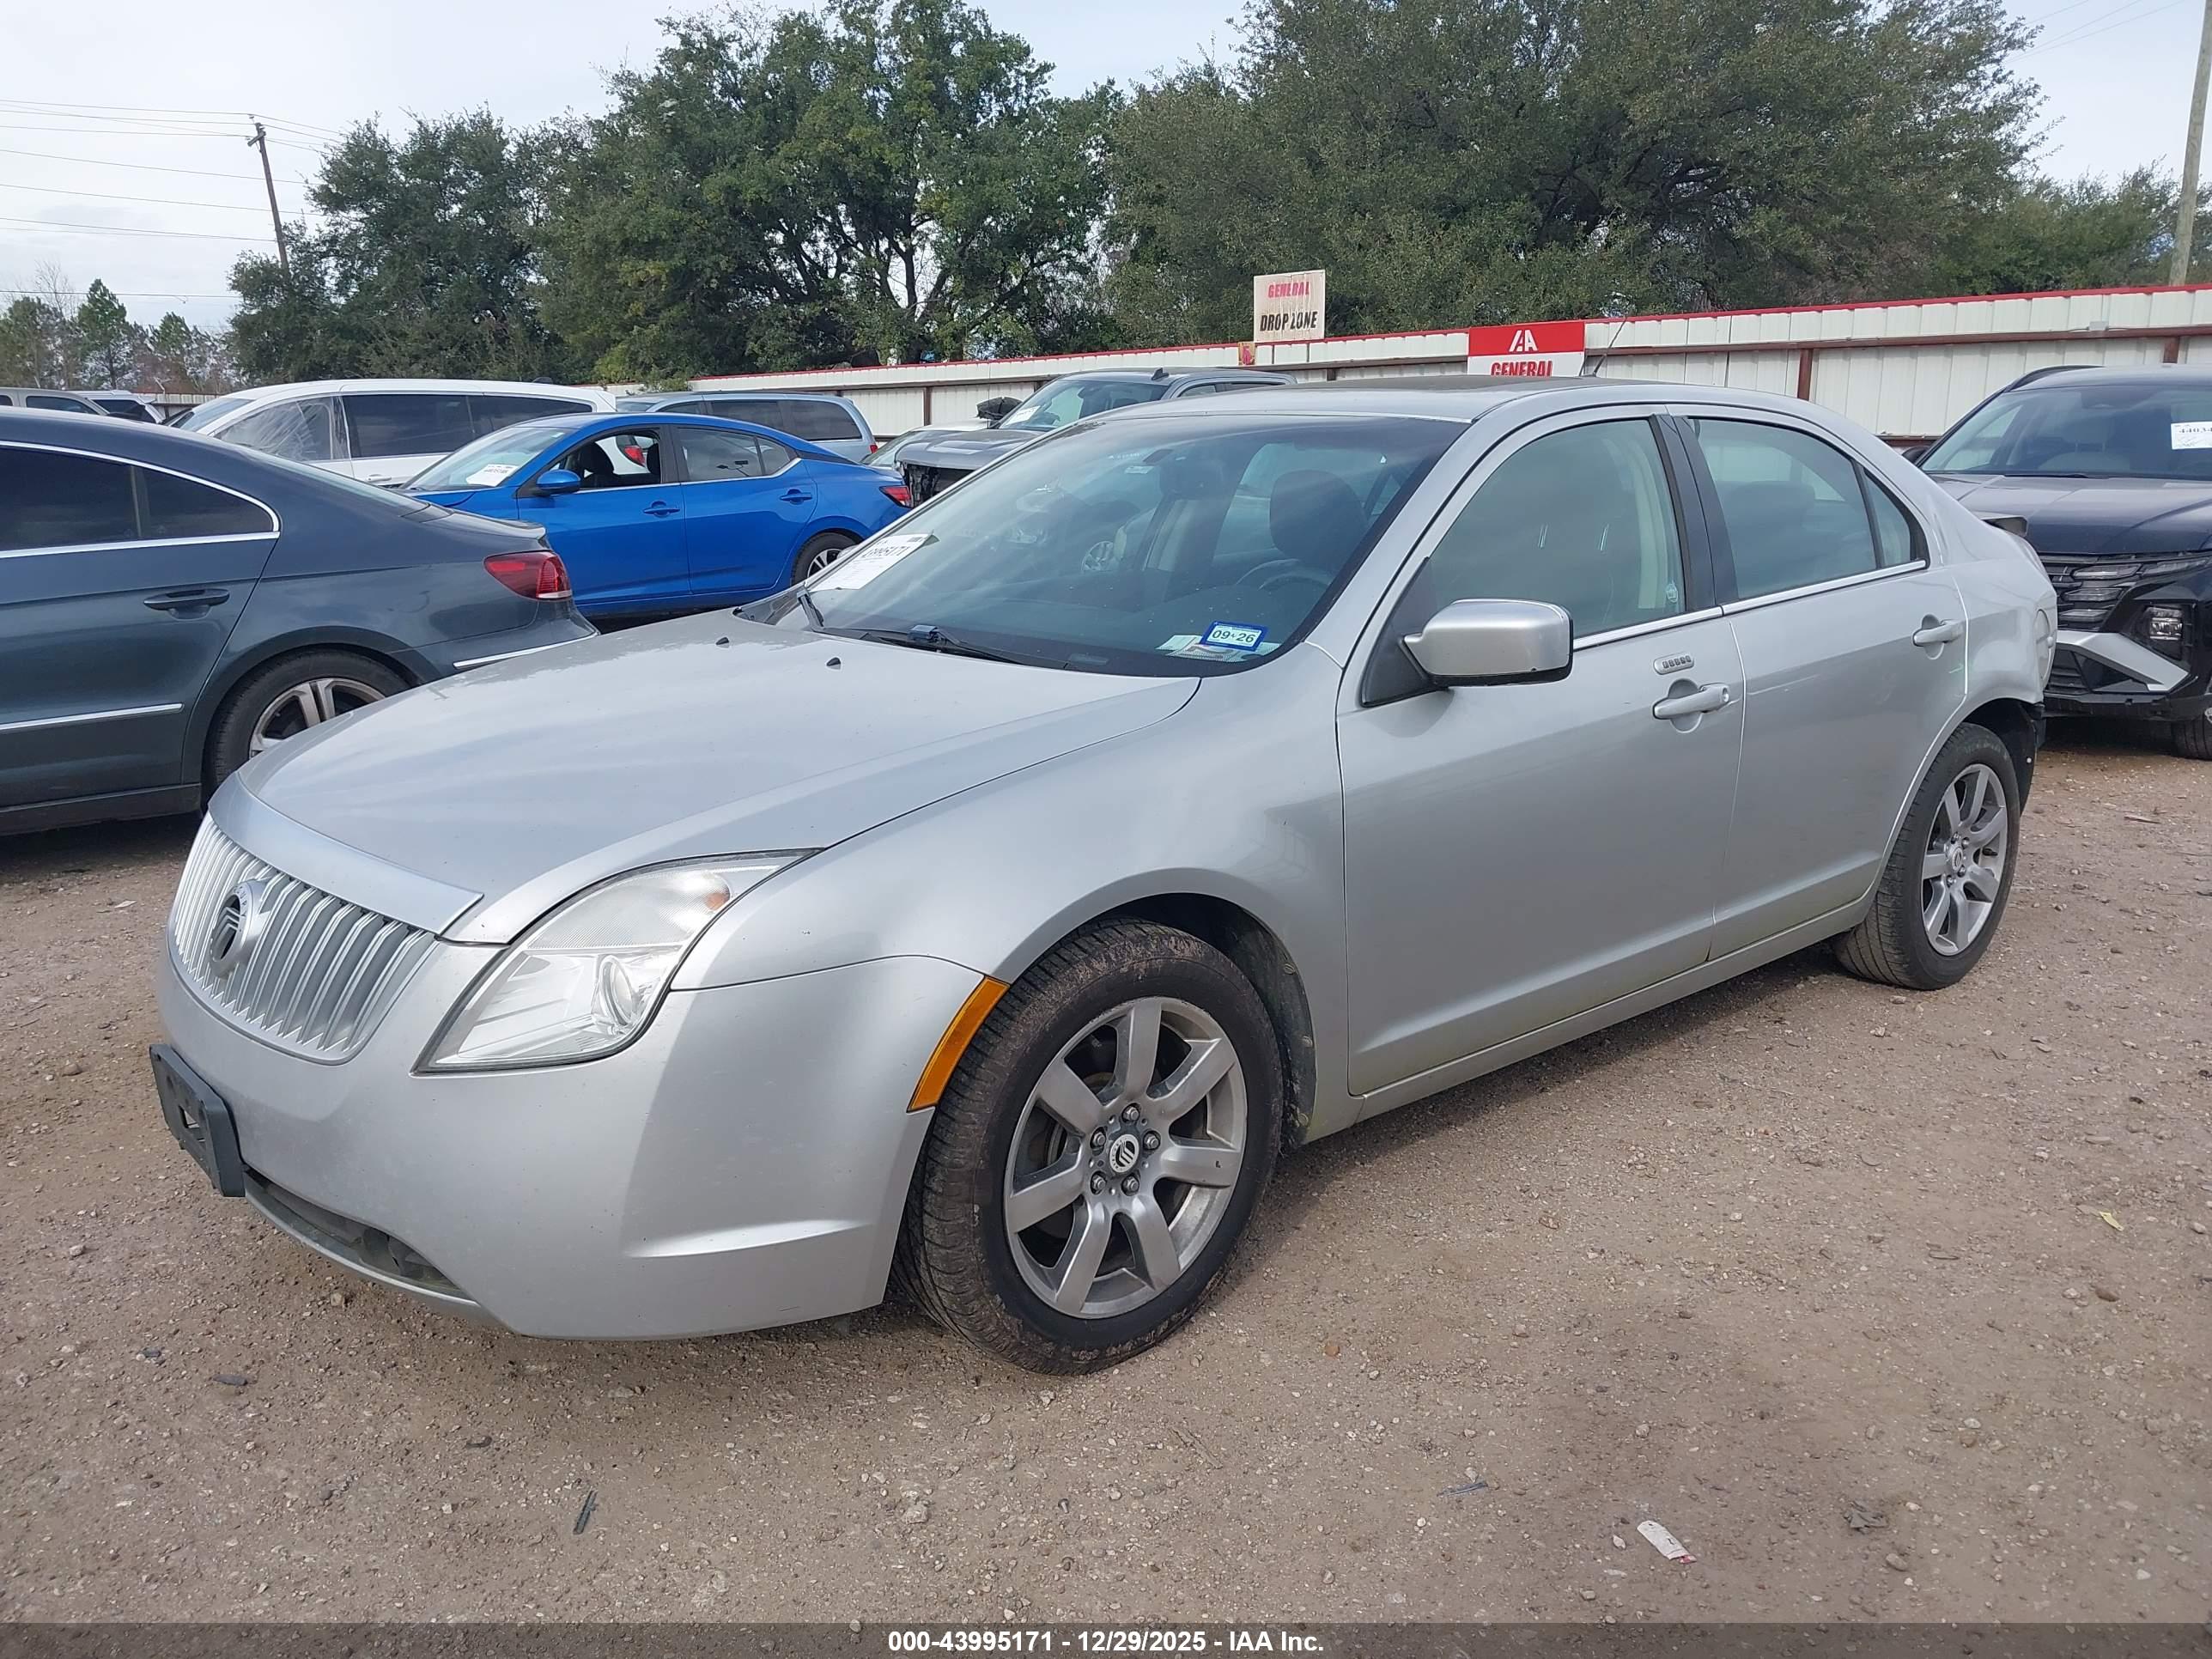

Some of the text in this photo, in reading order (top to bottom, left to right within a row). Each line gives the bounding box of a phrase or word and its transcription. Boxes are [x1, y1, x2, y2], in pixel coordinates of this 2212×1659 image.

[1267, 281, 1310, 298] GENERAL
[1260, 311, 1318, 331] DROP ZONE
